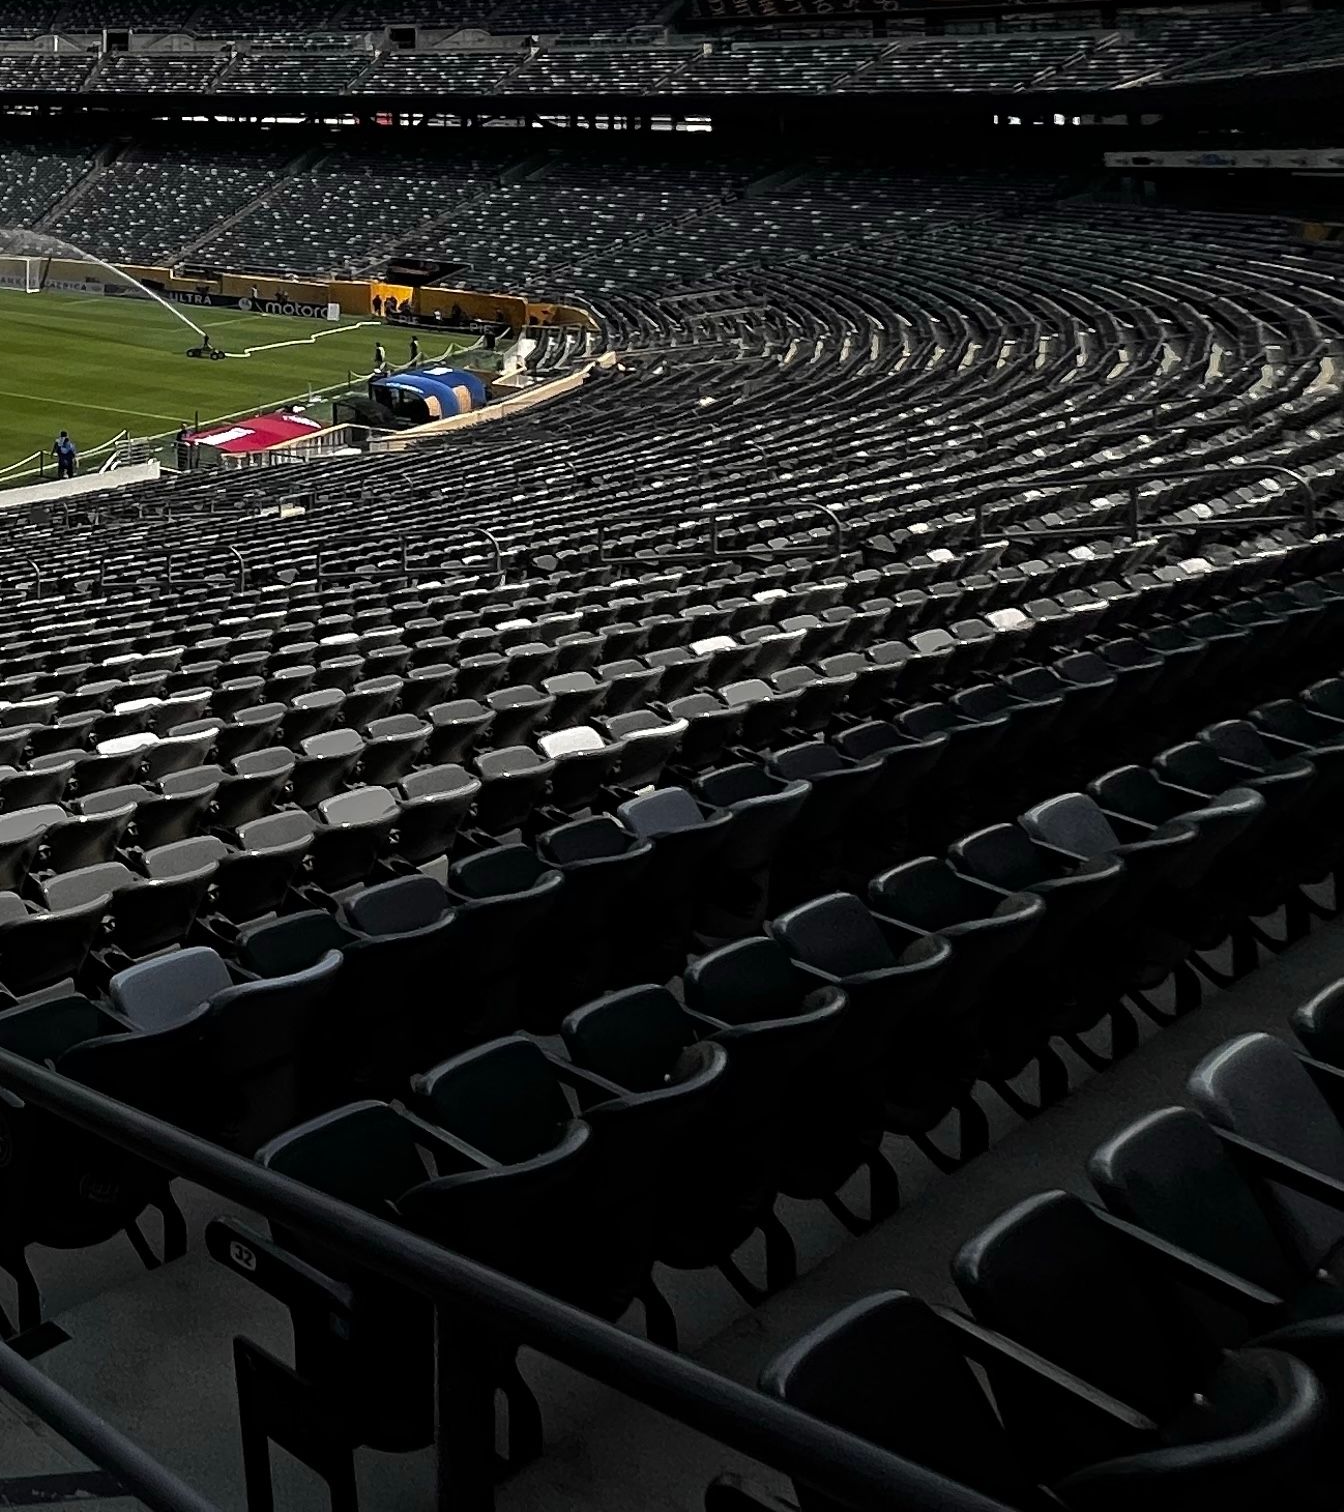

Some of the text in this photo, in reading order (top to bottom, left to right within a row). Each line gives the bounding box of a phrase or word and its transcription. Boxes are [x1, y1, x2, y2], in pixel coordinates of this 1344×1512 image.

[170, 291, 212, 305] ULTRA
[265, 300, 328, 318] motoro
[234, 1244, 253, 1266] 32
